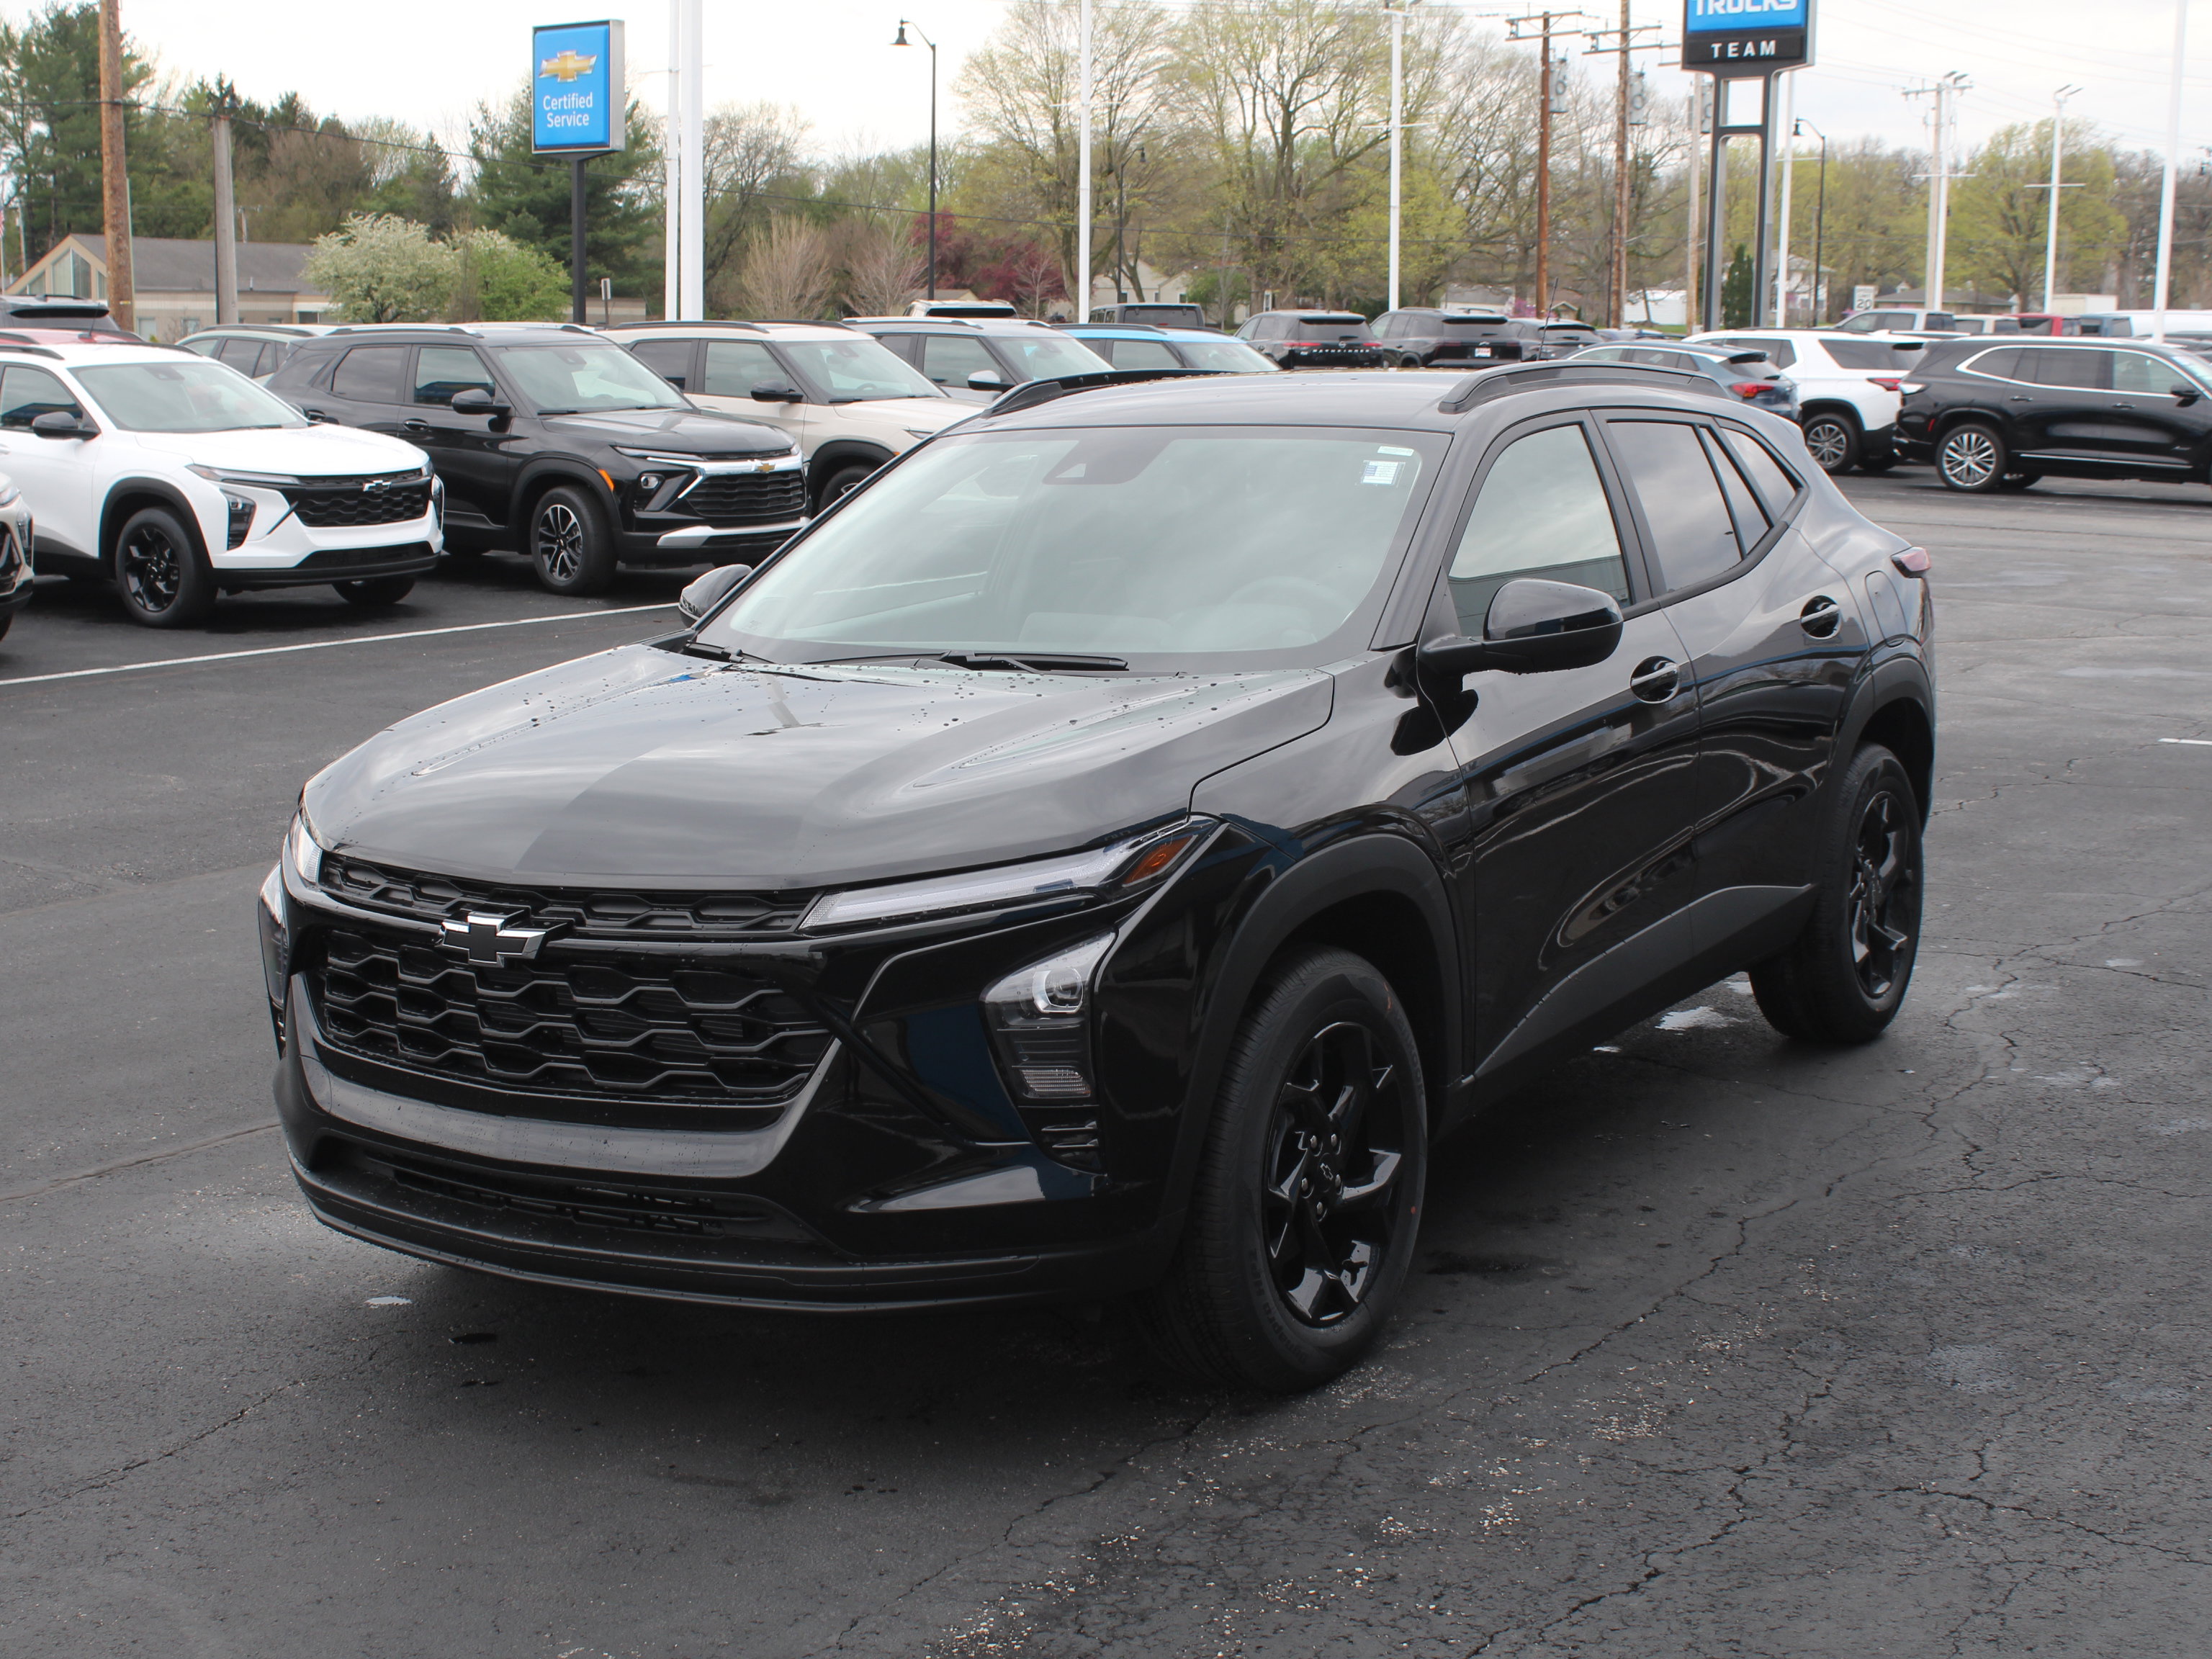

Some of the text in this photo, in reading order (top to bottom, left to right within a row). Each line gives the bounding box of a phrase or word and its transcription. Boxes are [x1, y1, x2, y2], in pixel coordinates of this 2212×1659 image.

[1696, 0, 1798, 16] TRUCKS
[1711, 40, 1777, 58] TEAM
[543, 91, 593, 110] Certified
[547, 111, 590, 127] Service
[1857, 299, 1873, 310] 20
